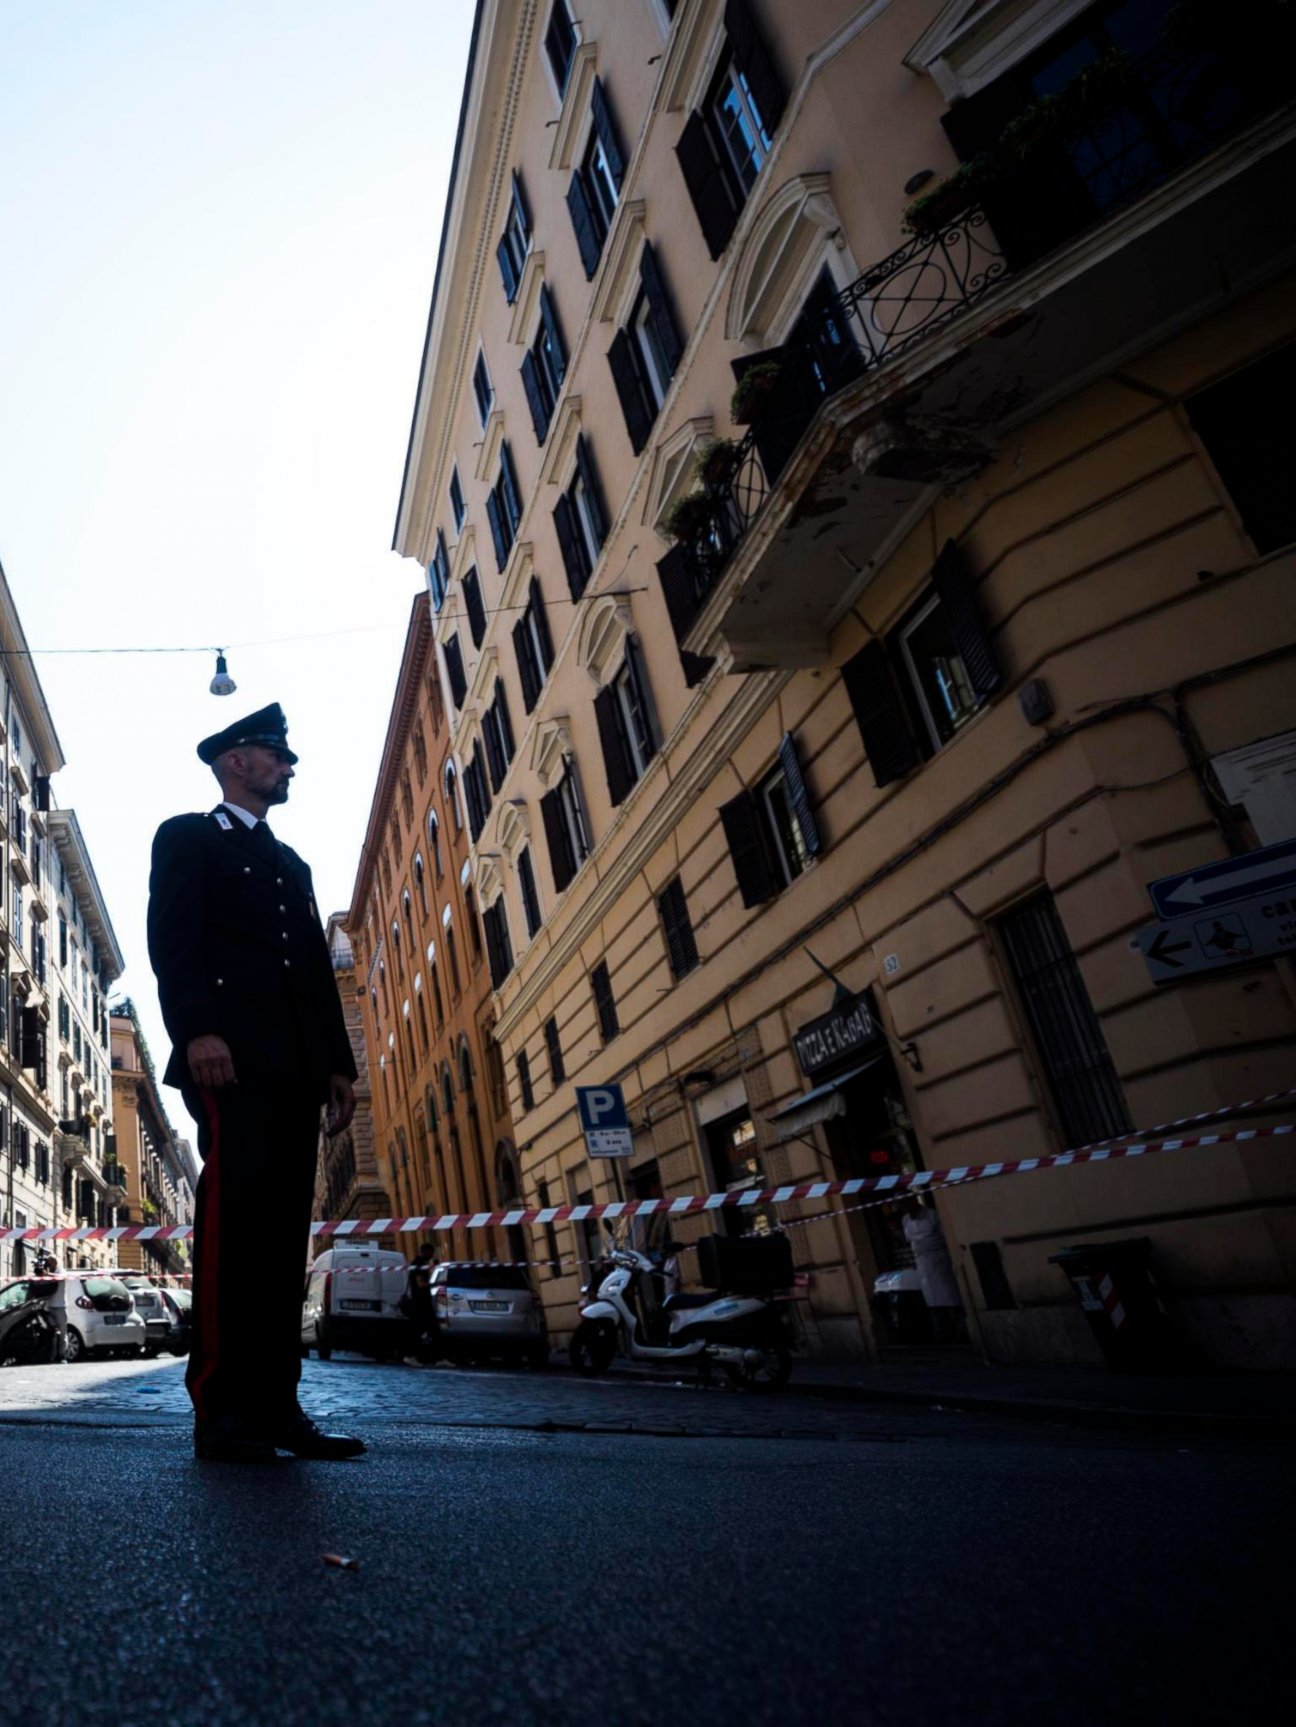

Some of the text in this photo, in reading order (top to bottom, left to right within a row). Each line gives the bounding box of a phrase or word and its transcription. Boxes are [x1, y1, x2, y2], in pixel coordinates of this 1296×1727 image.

[796, 1029, 829, 1068] PIZZA
[825, 1027, 837, 1054] E
[585, 1090, 615, 1125] P
